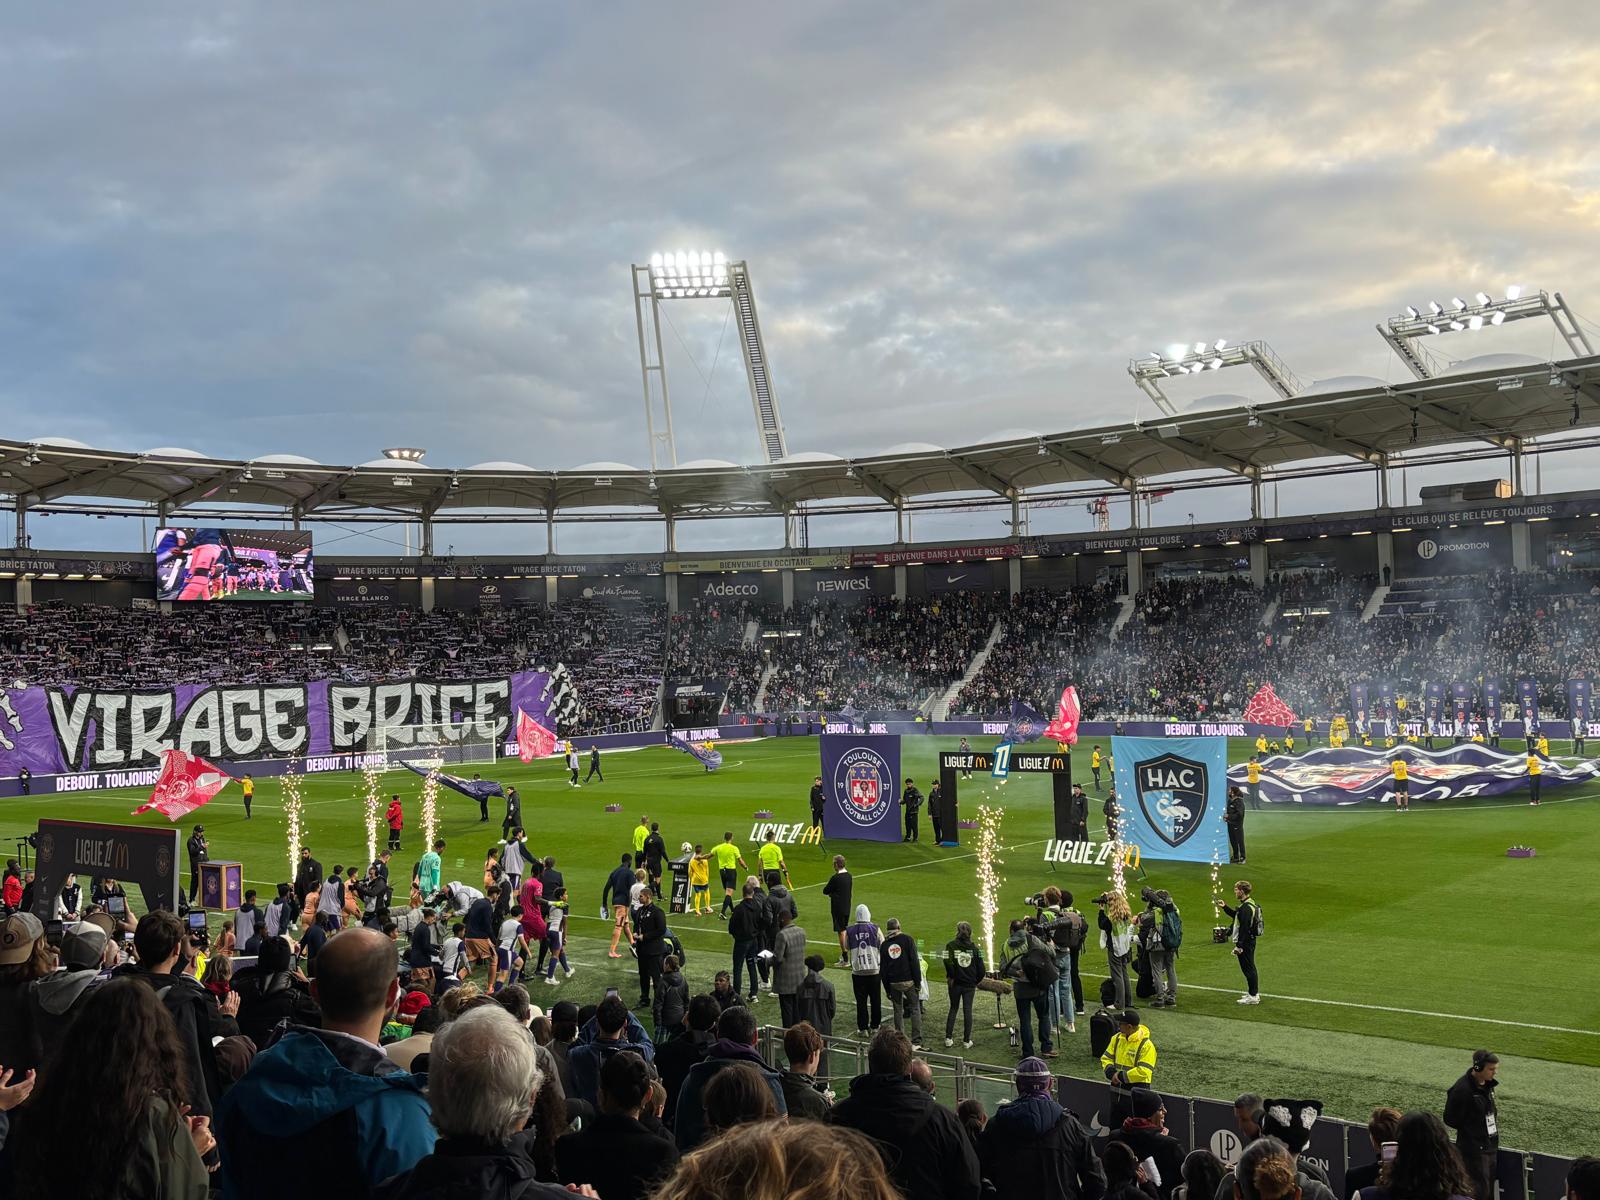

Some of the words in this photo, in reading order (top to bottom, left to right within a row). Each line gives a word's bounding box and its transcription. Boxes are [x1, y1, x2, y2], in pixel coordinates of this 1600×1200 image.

[1392, 516, 1403, 526] LE
[1405, 515, 1429, 526] CLUB
[1431, 514, 1446, 524] QUI
[1449, 513, 1461, 522] SE
[1463, 509, 1499, 520] RELÈVE
[1502, 505, 1556, 517] TOUJOURS.
[1085, 539, 1129, 549] BIENVENUE
[1140, 536, 1184, 546] TOULOUSE.
[1439, 542, 1490, 552] PROMOTION
[884, 552, 926, 562] BIENVENUE
[927, 550, 948, 559] DANS
[949, 549, 960, 557] LA
[961, 548, 982, 557] VILLE
[984, 547, 1007, 556] ROSE.
[0, 560, 25, 569] BRICE
[26, 561, 55, 570] TATON
[338, 567, 365, 575] VIRAGE
[367, 567, 389, 575] BRICE
[391, 567, 415, 575] TATON
[720, 560, 761, 569] BIENVENUE
[763, 560, 773, 568] EN
[774, 558, 815, 567] OCCITANIE.
[704, 582, 759, 596] Adecco
[816, 576, 871, 592] newrest
[331, 679, 510, 747] BRICE
[48, 686, 306, 765] VIRAGE
[1165, 723, 1199, 736] DEBOUT.
[1200, 723, 1248, 737] TOUJOURS.
[306, 757, 343, 772] DEBOUT.
[843, 752, 882, 768] TOULOUSE
[56, 774, 103, 792] DEBOUT.
[1147, 768, 1196, 788] HAC
[883, 783, 890, 791] 37
[842, 798, 873, 821] FOOTBALL
[872, 801, 887, 818] CLUB
